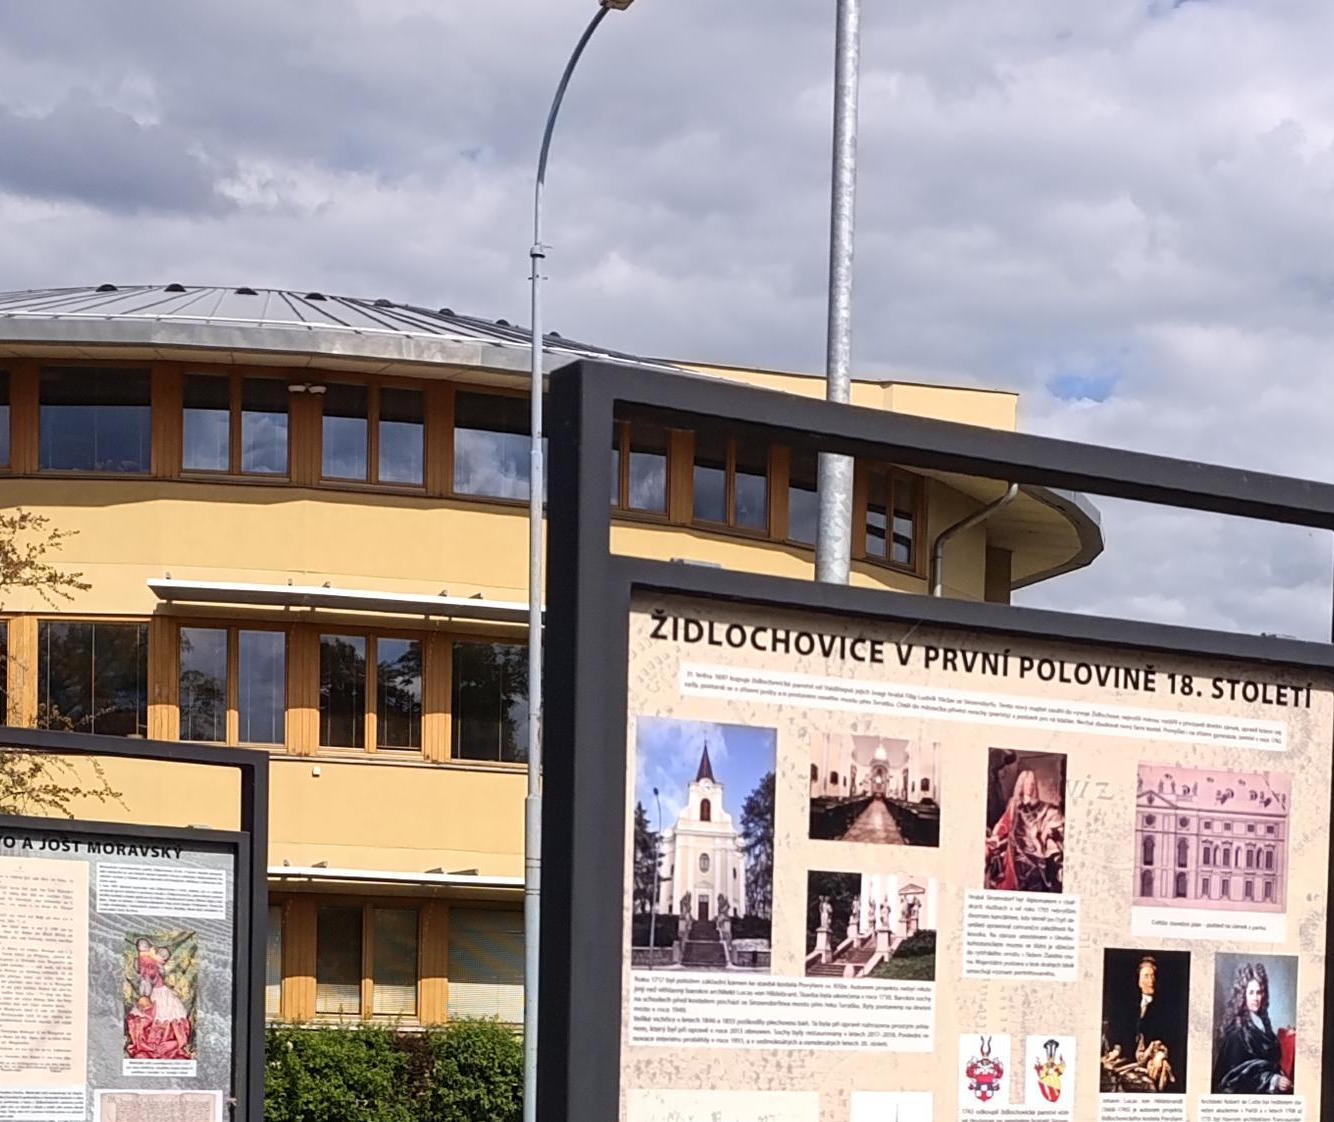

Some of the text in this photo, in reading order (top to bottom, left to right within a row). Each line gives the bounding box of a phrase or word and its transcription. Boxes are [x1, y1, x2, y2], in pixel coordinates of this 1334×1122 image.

[650, 608, 1314, 708] ŽIDLOCHOVICE V PRVNÍ POLOVINĚ 18. STOLETÍ
[22, 837, 34, 850] A
[39, 836, 81, 854] JOŠT
[87, 841, 183, 861] MORAVSKÝ
